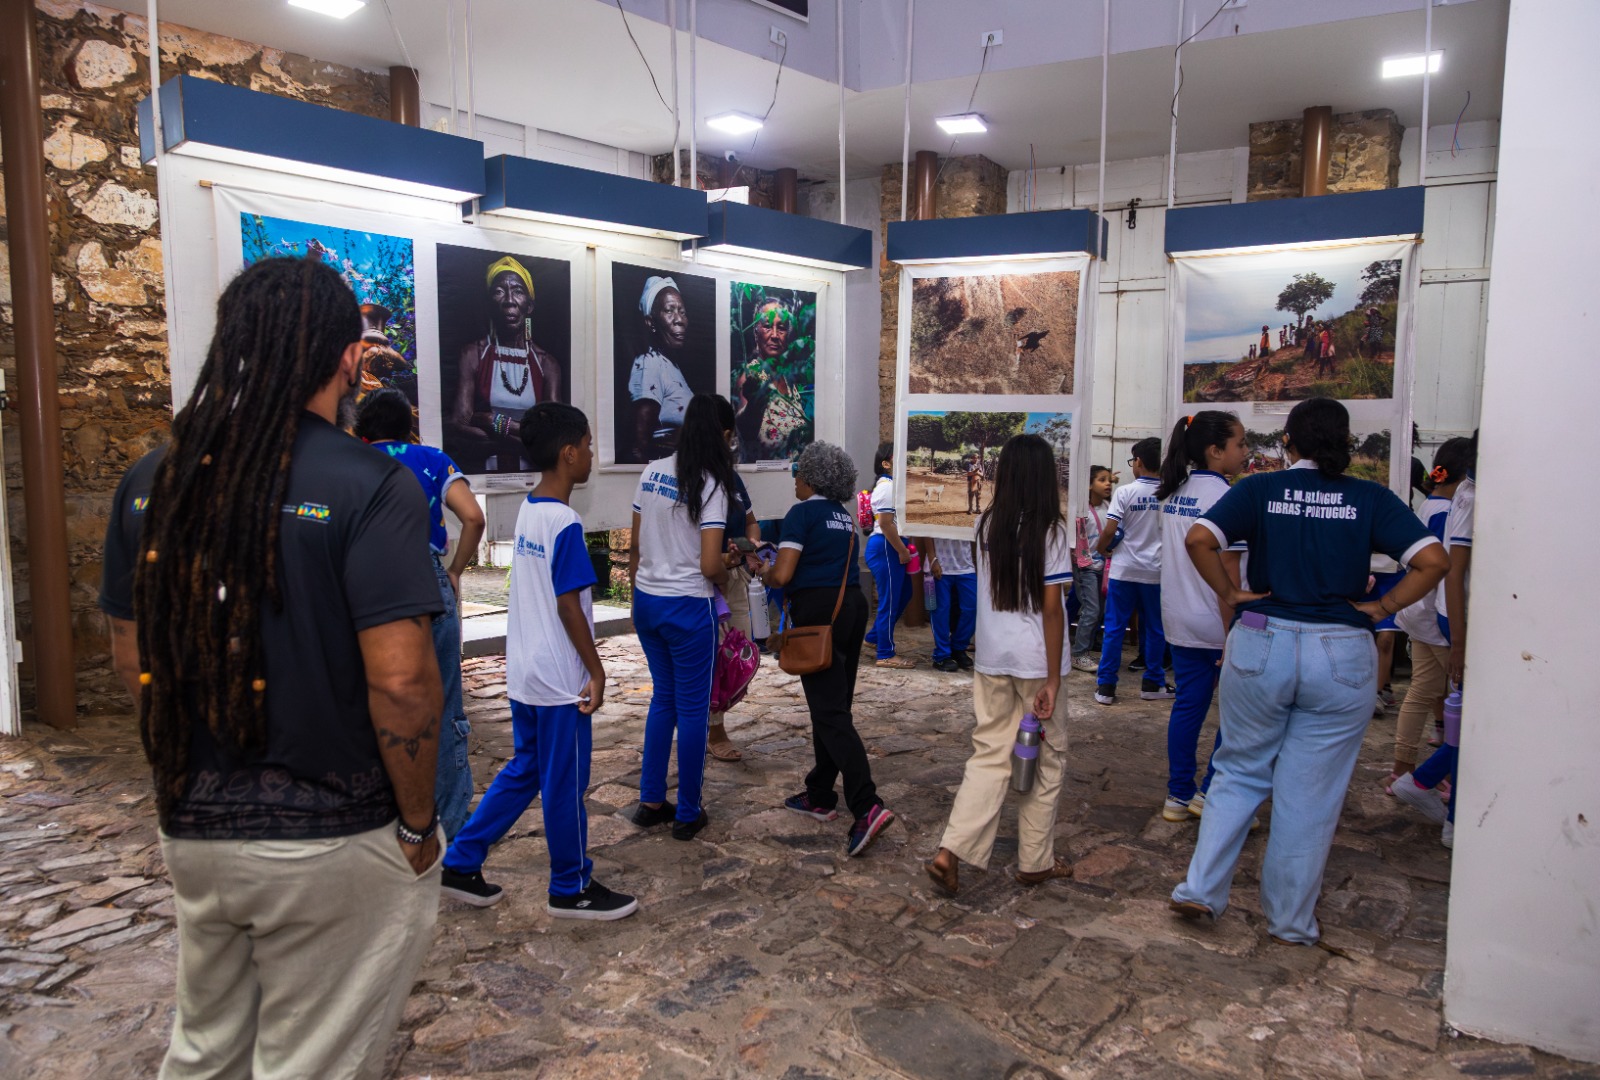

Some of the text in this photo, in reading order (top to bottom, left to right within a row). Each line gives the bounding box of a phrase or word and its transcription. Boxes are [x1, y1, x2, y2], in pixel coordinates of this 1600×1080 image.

[1284, 489, 1292, 501] E.
[1293, 490, 1305, 502] M.
[1267, 501, 1301, 516] LIBRAS
[1305, 504, 1357, 520] PORTUGUÊS
